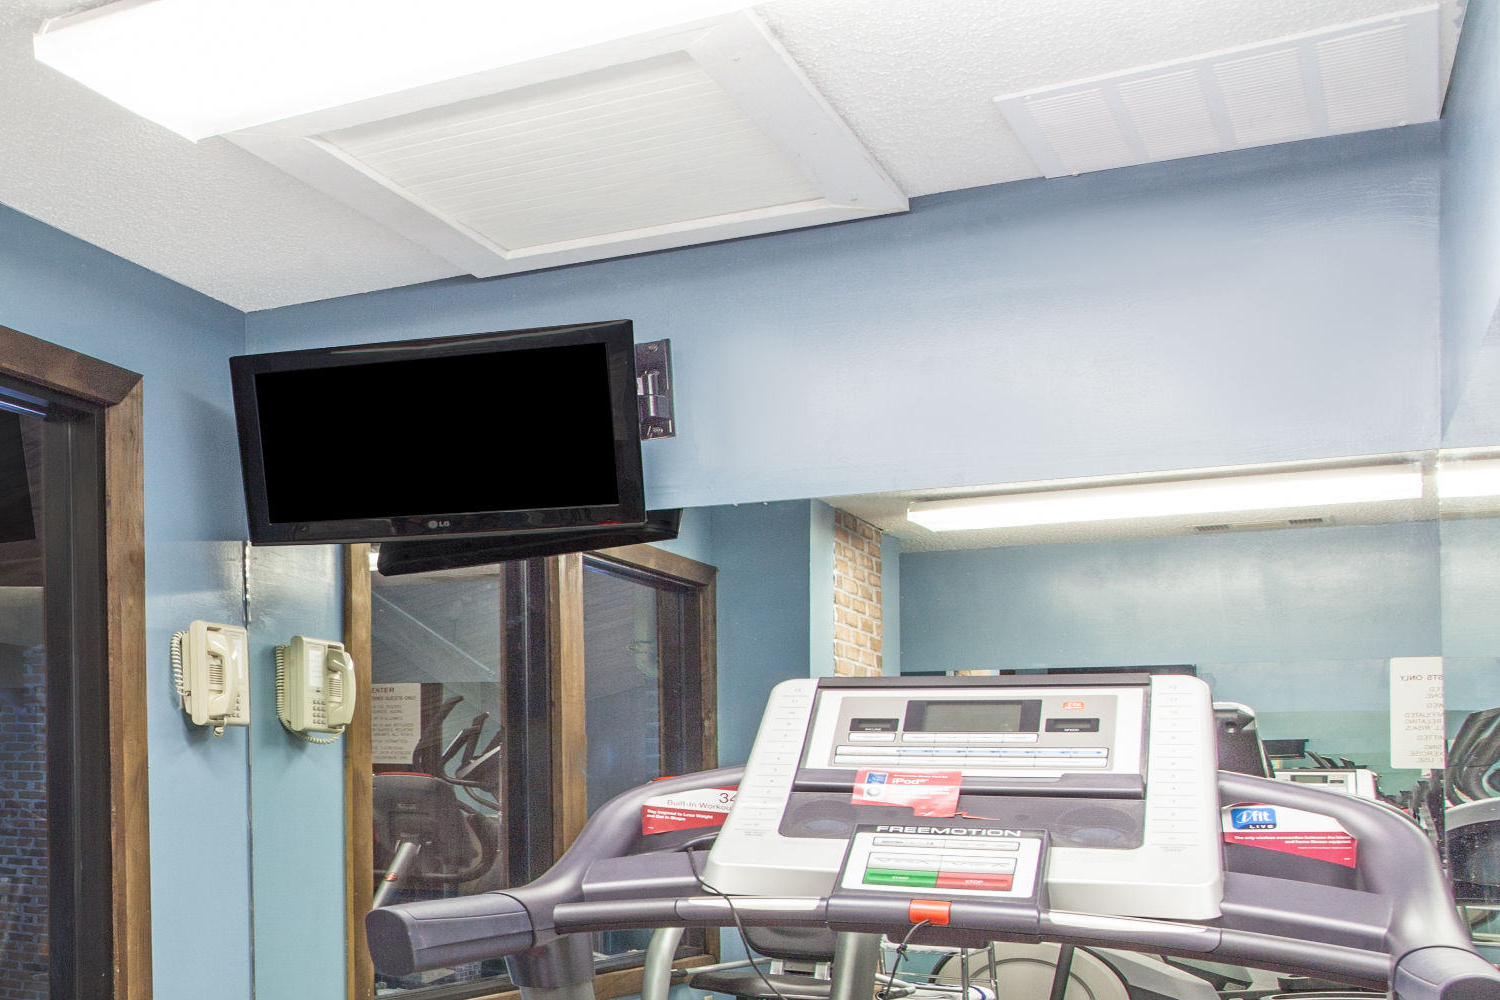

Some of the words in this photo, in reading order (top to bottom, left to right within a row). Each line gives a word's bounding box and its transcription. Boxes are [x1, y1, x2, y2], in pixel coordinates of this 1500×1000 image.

[438, 520, 450, 528] LG
[891, 777, 920, 785] iPod
[667, 799, 697, 809] Built-In
[699, 802, 732, 811] Workou
[876, 825, 1022, 837] FREEMOTION
